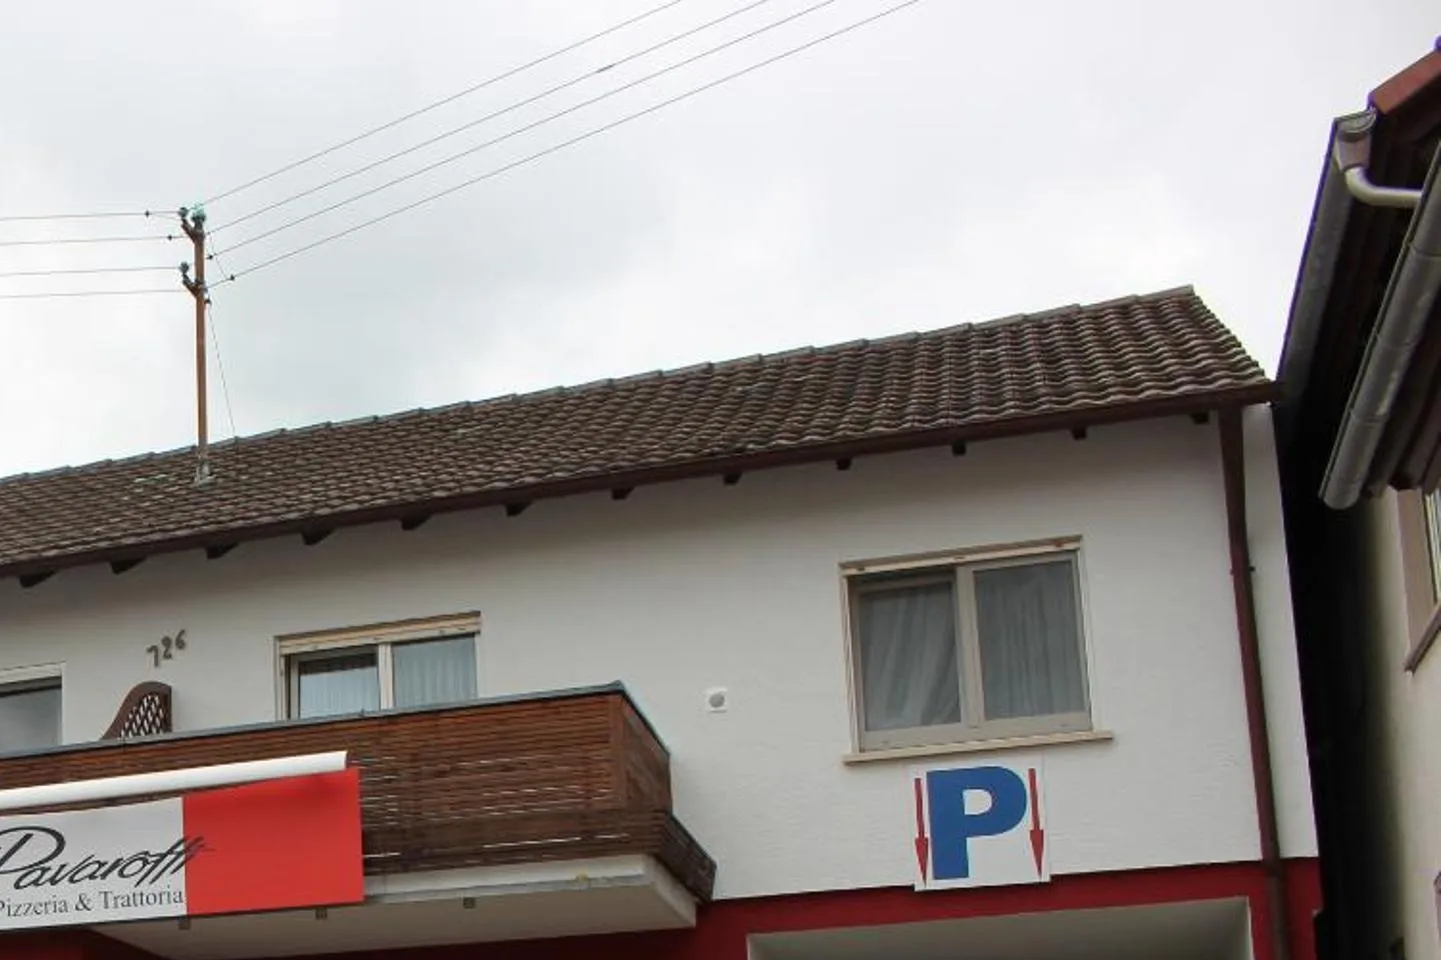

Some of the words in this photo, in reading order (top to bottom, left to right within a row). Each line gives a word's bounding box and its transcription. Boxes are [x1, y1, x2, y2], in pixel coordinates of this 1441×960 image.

[926, 765, 1027, 880] P
[75, 893, 92, 912] &
[99, 884, 184, 910] Trattoria
